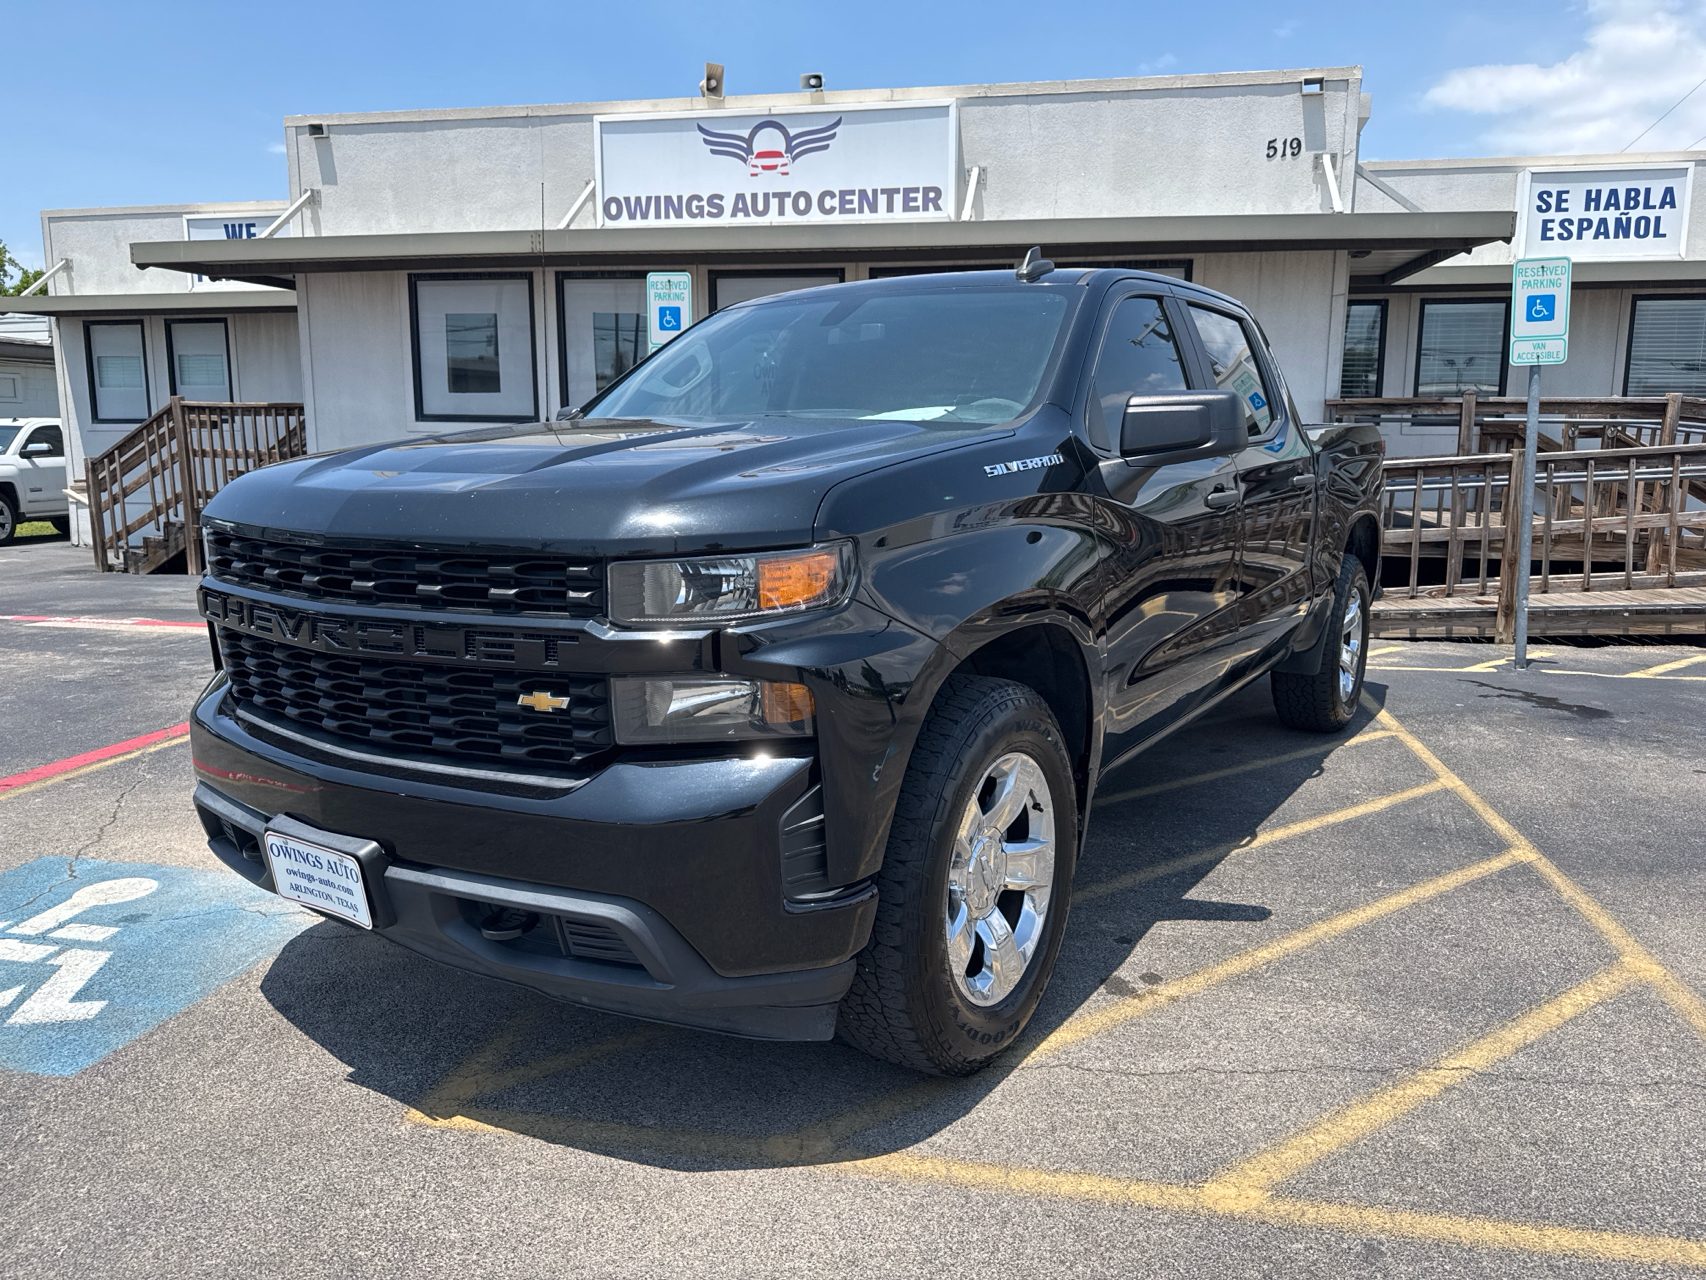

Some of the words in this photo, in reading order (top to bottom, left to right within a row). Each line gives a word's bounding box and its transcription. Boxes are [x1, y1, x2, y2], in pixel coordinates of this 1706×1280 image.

[1265, 137, 1302, 158] 519
[603, 193, 725, 221] OWINGS
[730, 190, 814, 218] AUTO
[817, 186, 943, 215] CENTER
[1536, 190, 1570, 213] SE
[1584, 186, 1677, 212] HABLA
[1540, 212, 1667, 241] ESPAÑOL
[1517, 265, 1567, 278] RESERVED
[650, 280, 688, 291] RESERVED
[1521, 278, 1562, 289] PARKING
[654, 291, 685, 301] PARKING
[1517, 350, 1561, 360] ACCESSIBLE
[1531, 342, 1546, 350] VAN
[984, 454, 1065, 477] SILVERADO
[204, 590, 580, 666] CHEVROLET
[270, 843, 323, 869] OWINGS
[327, 859, 359, 883] AUTO
[286, 868, 355, 896] owings-auto.com
[289, 882, 336, 904] ARLINGTON,
[336, 896, 359, 912] TEXAS
